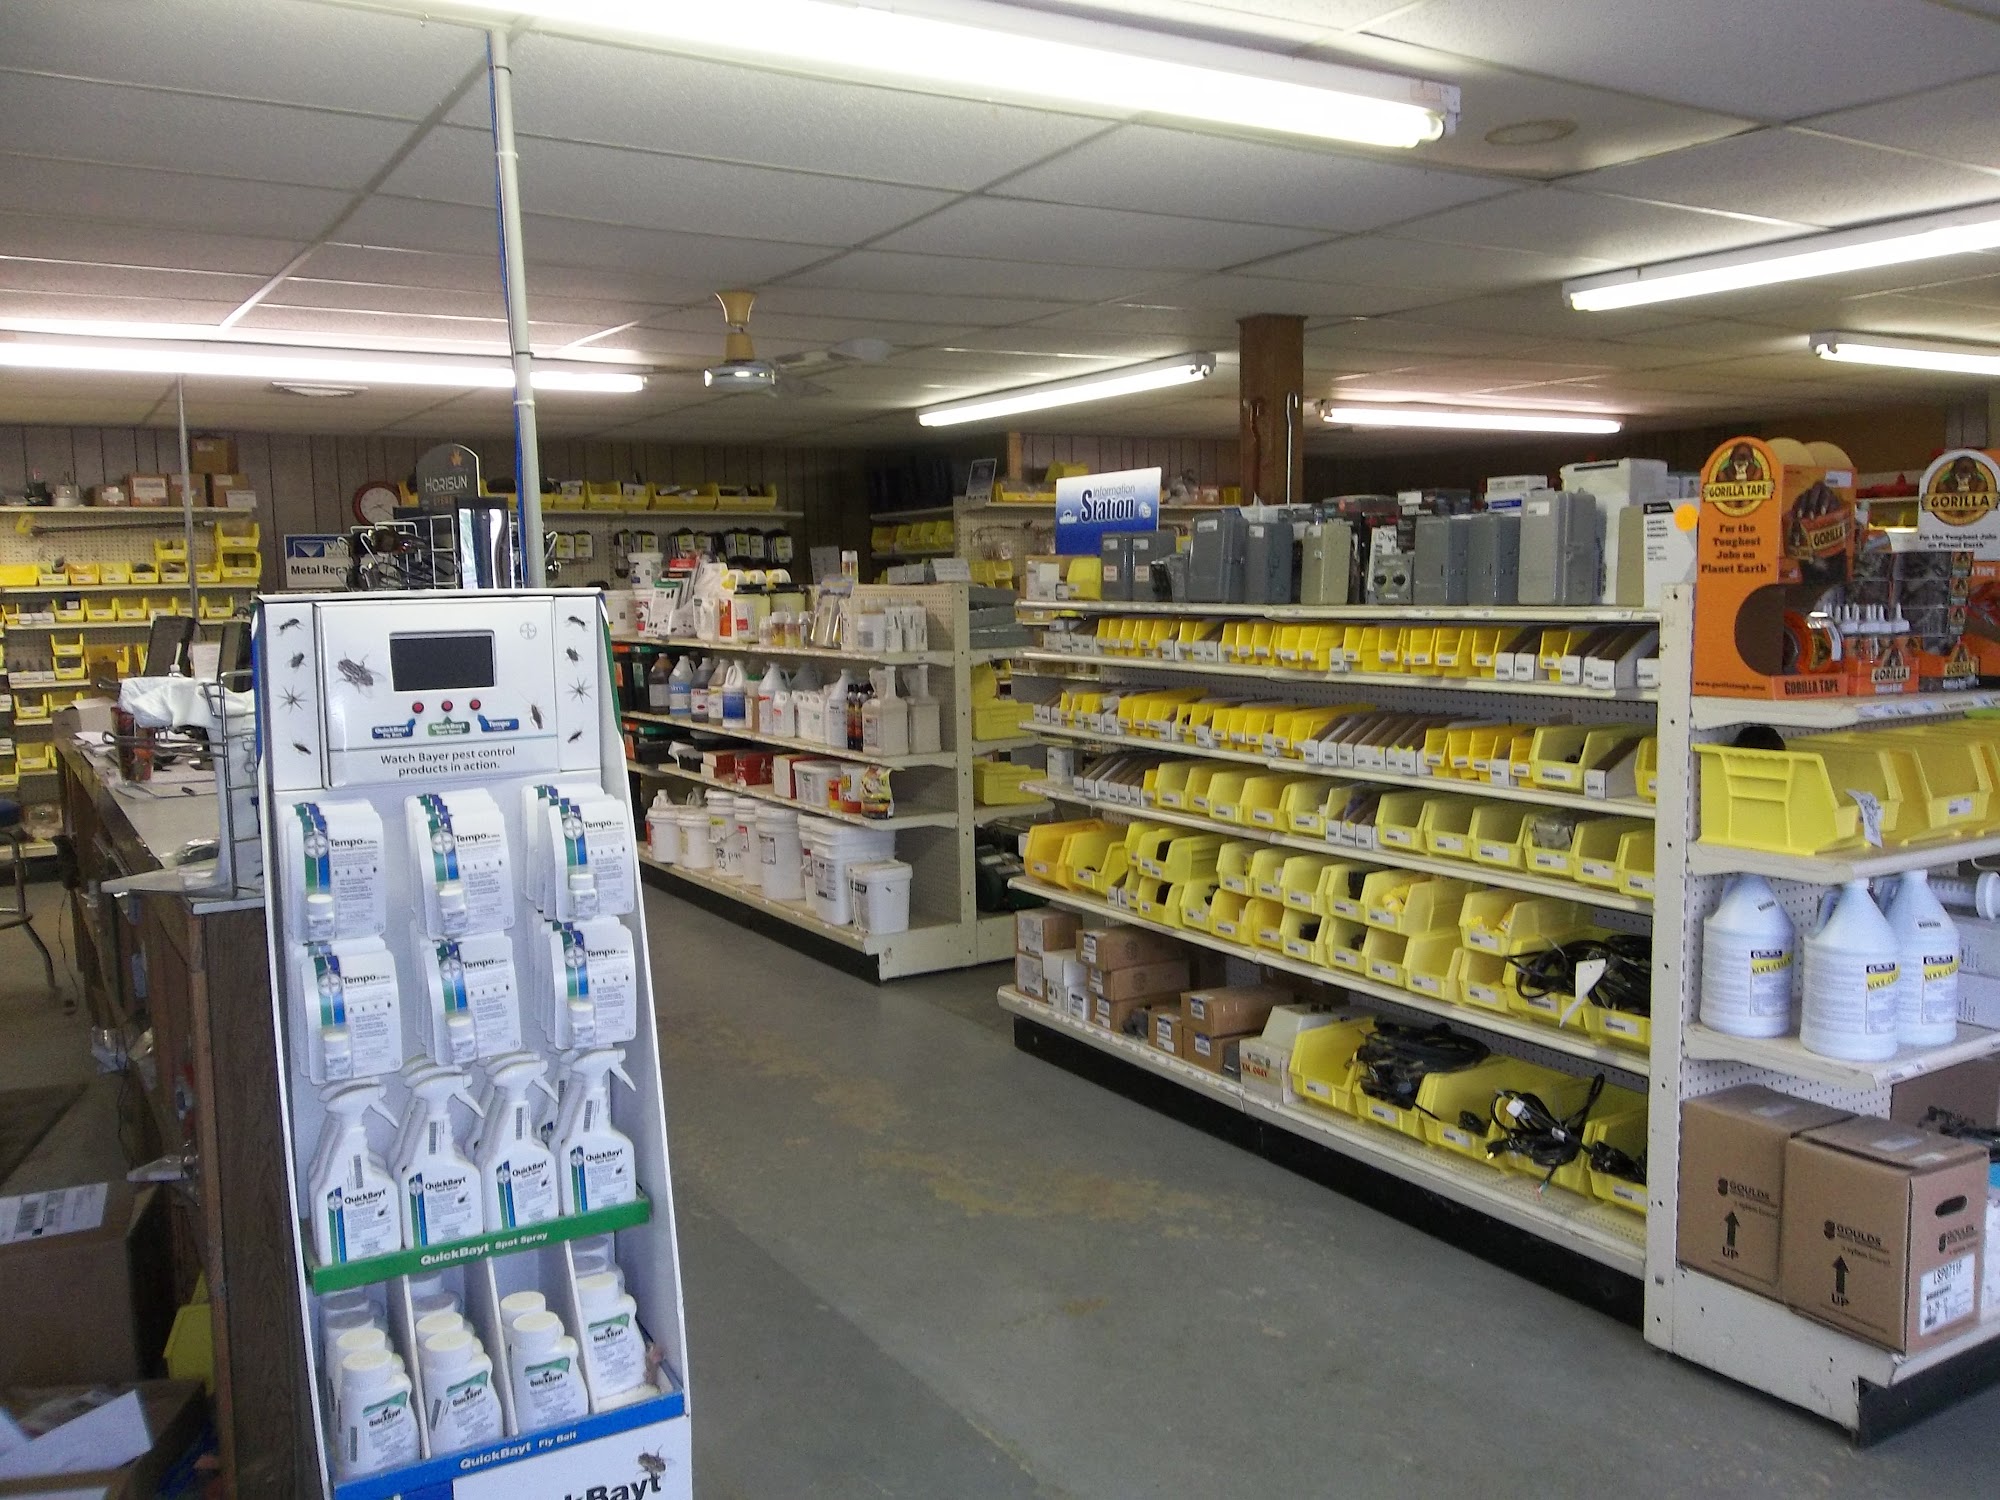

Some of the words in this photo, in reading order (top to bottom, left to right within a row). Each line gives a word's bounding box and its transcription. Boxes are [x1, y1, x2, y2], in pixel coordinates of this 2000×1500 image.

[424, 475, 468, 492] HORISUN
[1093, 483, 1136, 497] Information
[1708, 484, 1745, 498] GORILLA
[1747, 483, 1767, 496] TAPE
[1081, 489, 1135, 522] Station
[1930, 495, 1990, 508] GORILLA
[1719, 523, 1735, 534] For
[1738, 523, 1756, 533] the
[1813, 525, 1844, 546] GORILLA
[1712, 537, 1761, 548] Toughest
[1716, 551, 1741, 560] Jobs
[290, 564, 320, 576] Metal
[1701, 563, 1734, 574] Planet
[1874, 668, 1907, 681] GORILLA
[1784, 680, 1819, 695] GORILLA
[1819, 679, 1840, 693] TAPE
[380, 753, 416, 764] Watch
[418, 752, 449, 764] Bayer
[452, 749, 475, 761] pest
[478, 746, 516, 758] control
[398, 764, 449, 778] products
[450, 762, 461, 772] in
[463, 760, 501, 771] action.
[583, 820, 612, 830] Tempo
[329, 838, 363, 848] Tempo
[453, 832, 487, 843] Tempo
[585, 948, 616, 959] Tempo
[462, 959, 494, 969] Tempo
[341, 974, 376, 985] Tempo
[585, 1148, 623, 1162] QuickBayt
[512, 1160, 548, 1177] QuickBayt
[424, 1176, 467, 1191] QuickBayt
[1729, 1180, 1770, 1200] GOULDS
[344, 1188, 386, 1205] QuickBayt
[1836, 1223, 1881, 1246] GOULDS
[420, 1242, 490, 1266] QuickBayt
[495, 1237, 518, 1250] Spot
[520, 1232, 548, 1244] Spray
[1722, 1246, 1739, 1260] UP
[1831, 1293, 1850, 1307] UP
[459, 1440, 533, 1470] QuickBayt
[538, 1437, 554, 1449] Fly
[556, 1430, 577, 1443] Bait
